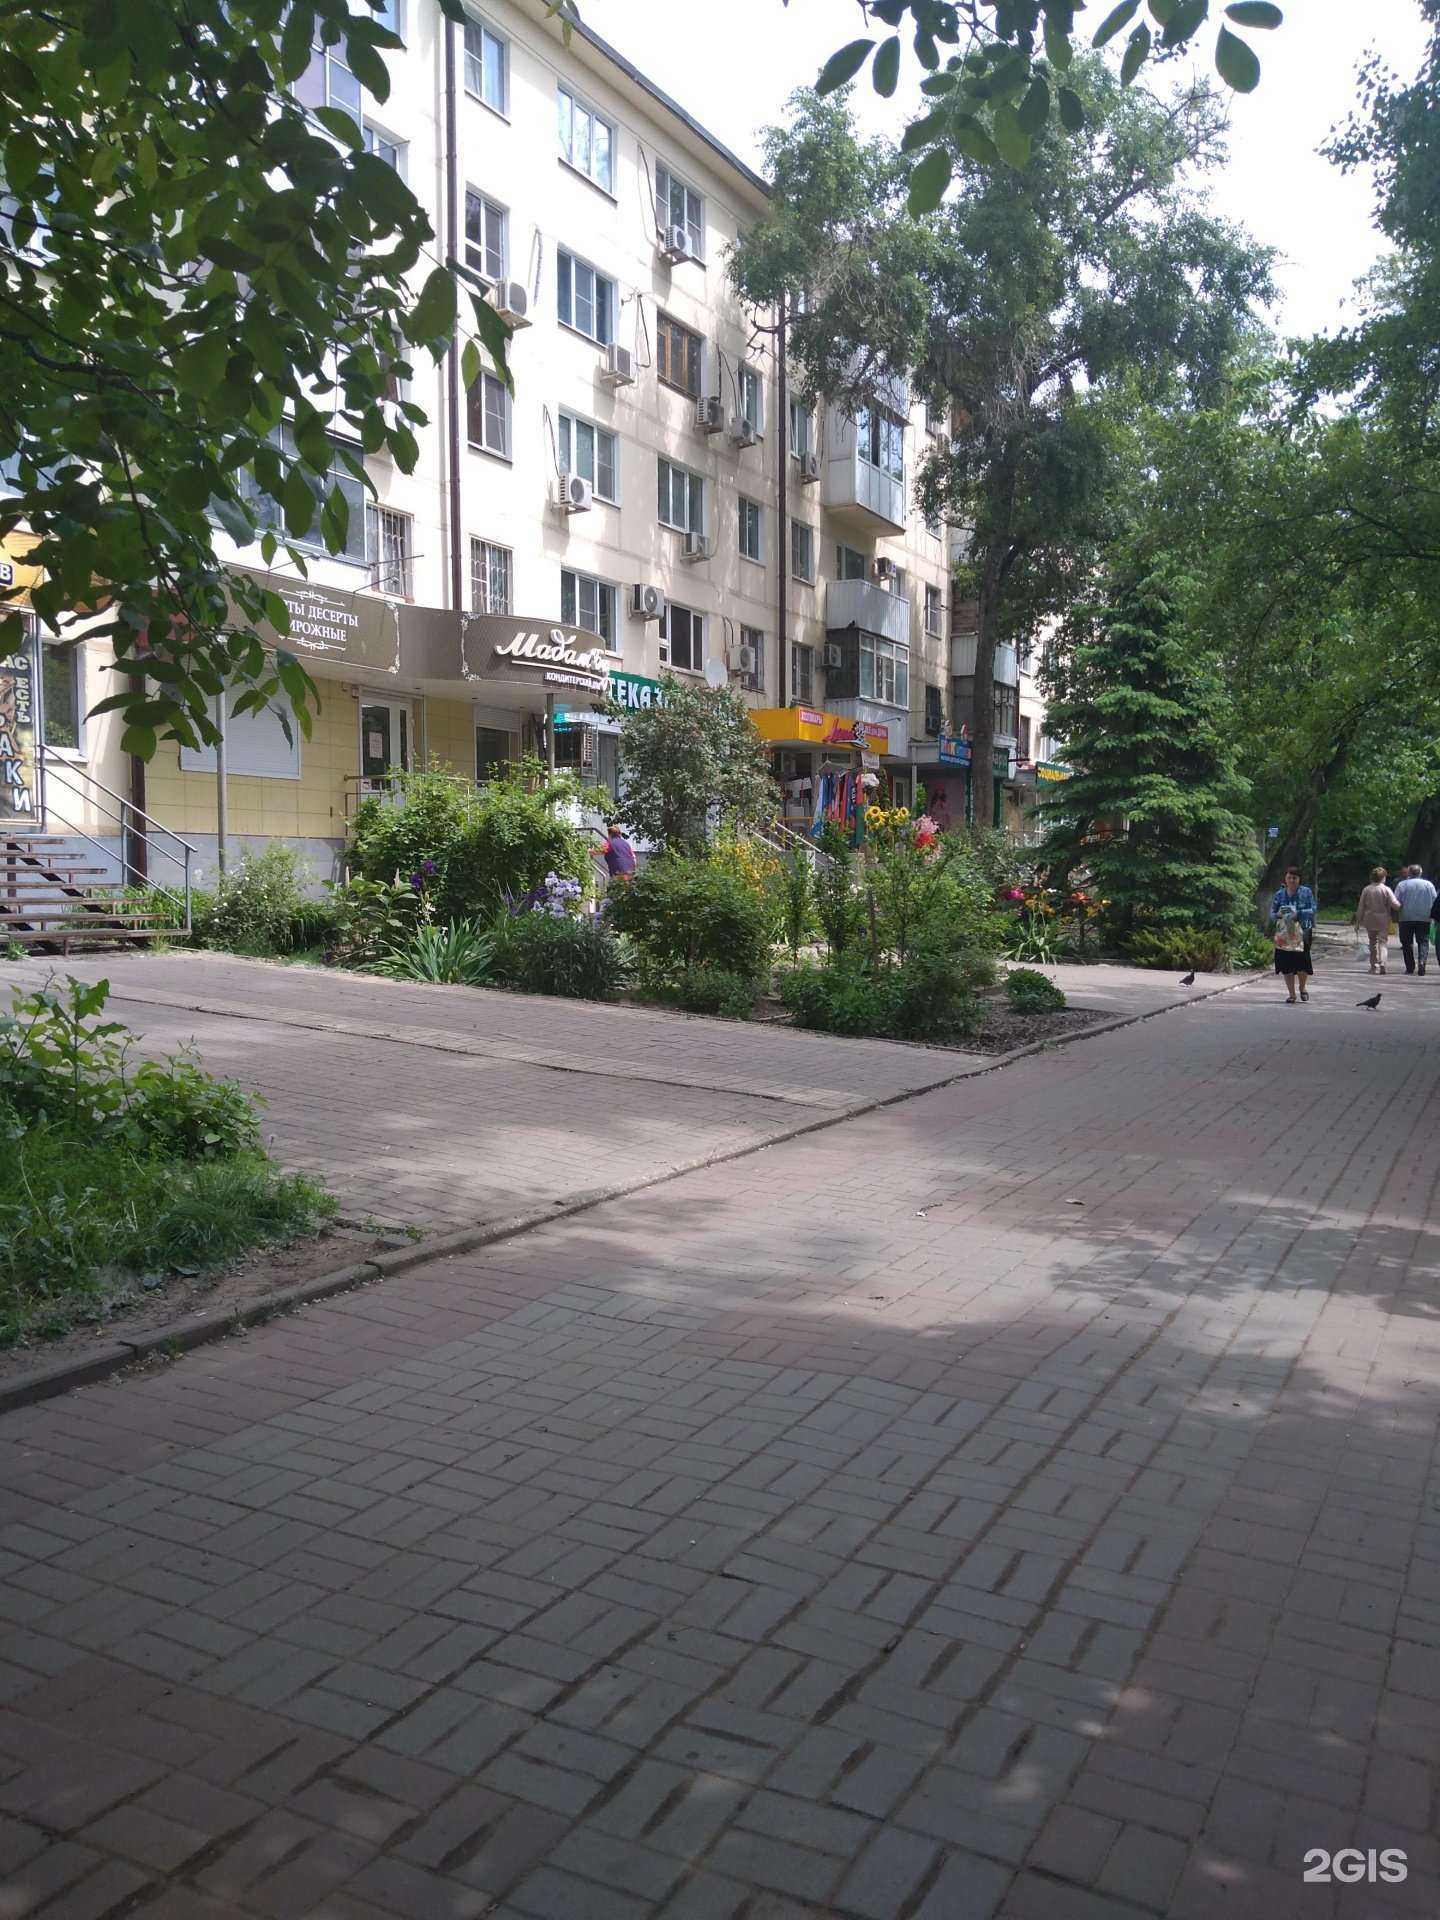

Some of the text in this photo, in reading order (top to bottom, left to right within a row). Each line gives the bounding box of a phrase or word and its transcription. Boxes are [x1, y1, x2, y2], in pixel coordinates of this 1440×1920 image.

[284, 600, 359, 627] ТЫ ДЕСЕРТЫ
[15, 677, 31, 723] ЕСТЬ
